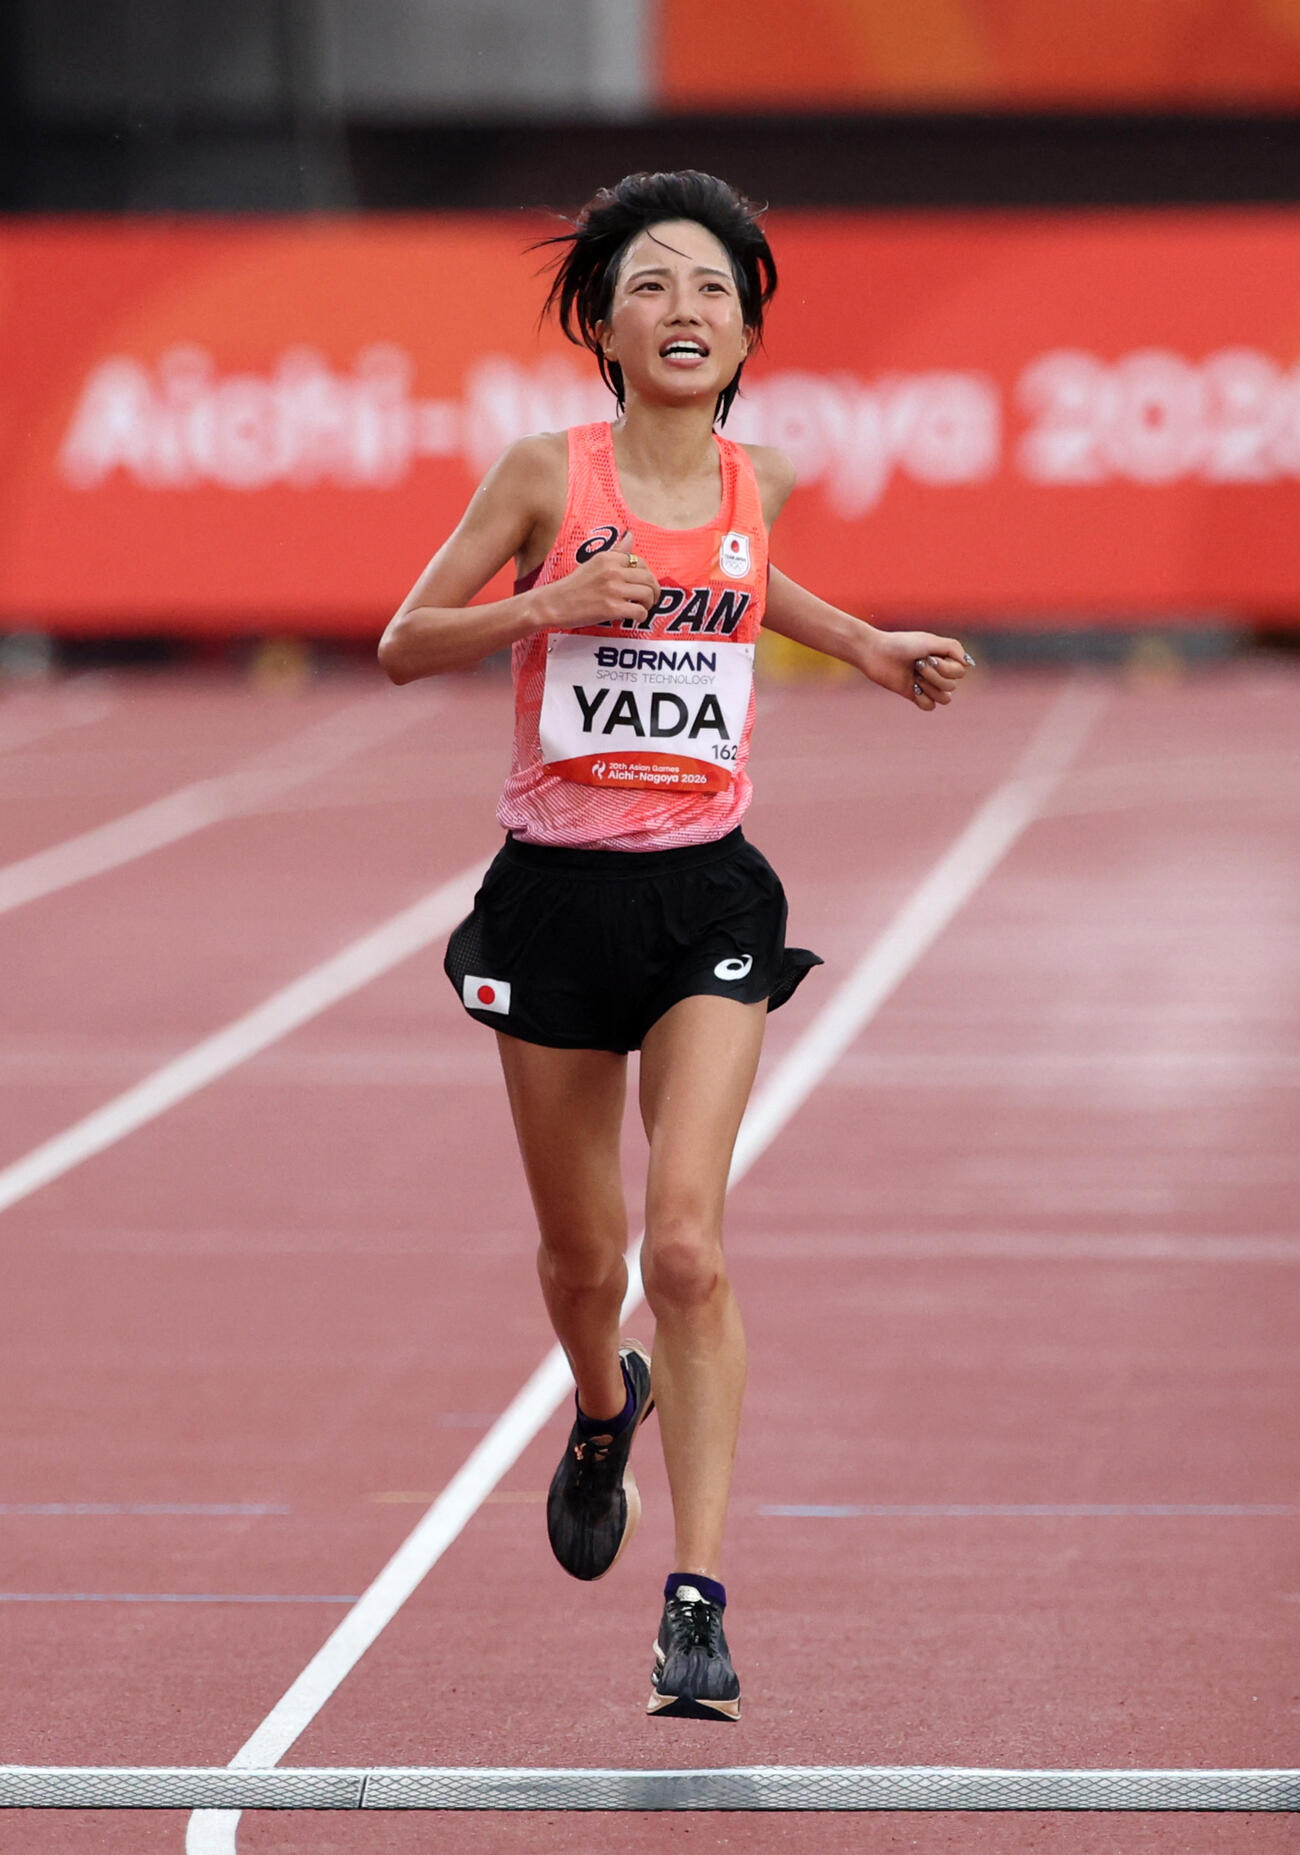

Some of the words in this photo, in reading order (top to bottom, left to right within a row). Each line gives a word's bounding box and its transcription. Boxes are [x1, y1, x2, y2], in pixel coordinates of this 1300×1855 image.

[597, 587, 751, 635] PAN
[594, 647, 716, 671] BORNAN
[596, 670, 637, 683] SPORTS
[643, 673, 715, 685] TECHNOLOGY
[573, 686, 729, 740] YADA
[608, 770, 679, 784] Aichi-Nagoya
[681, 774, 707, 784] 2026
[609, 762, 627, 770] 20th
[652, 765, 679, 773] Games
